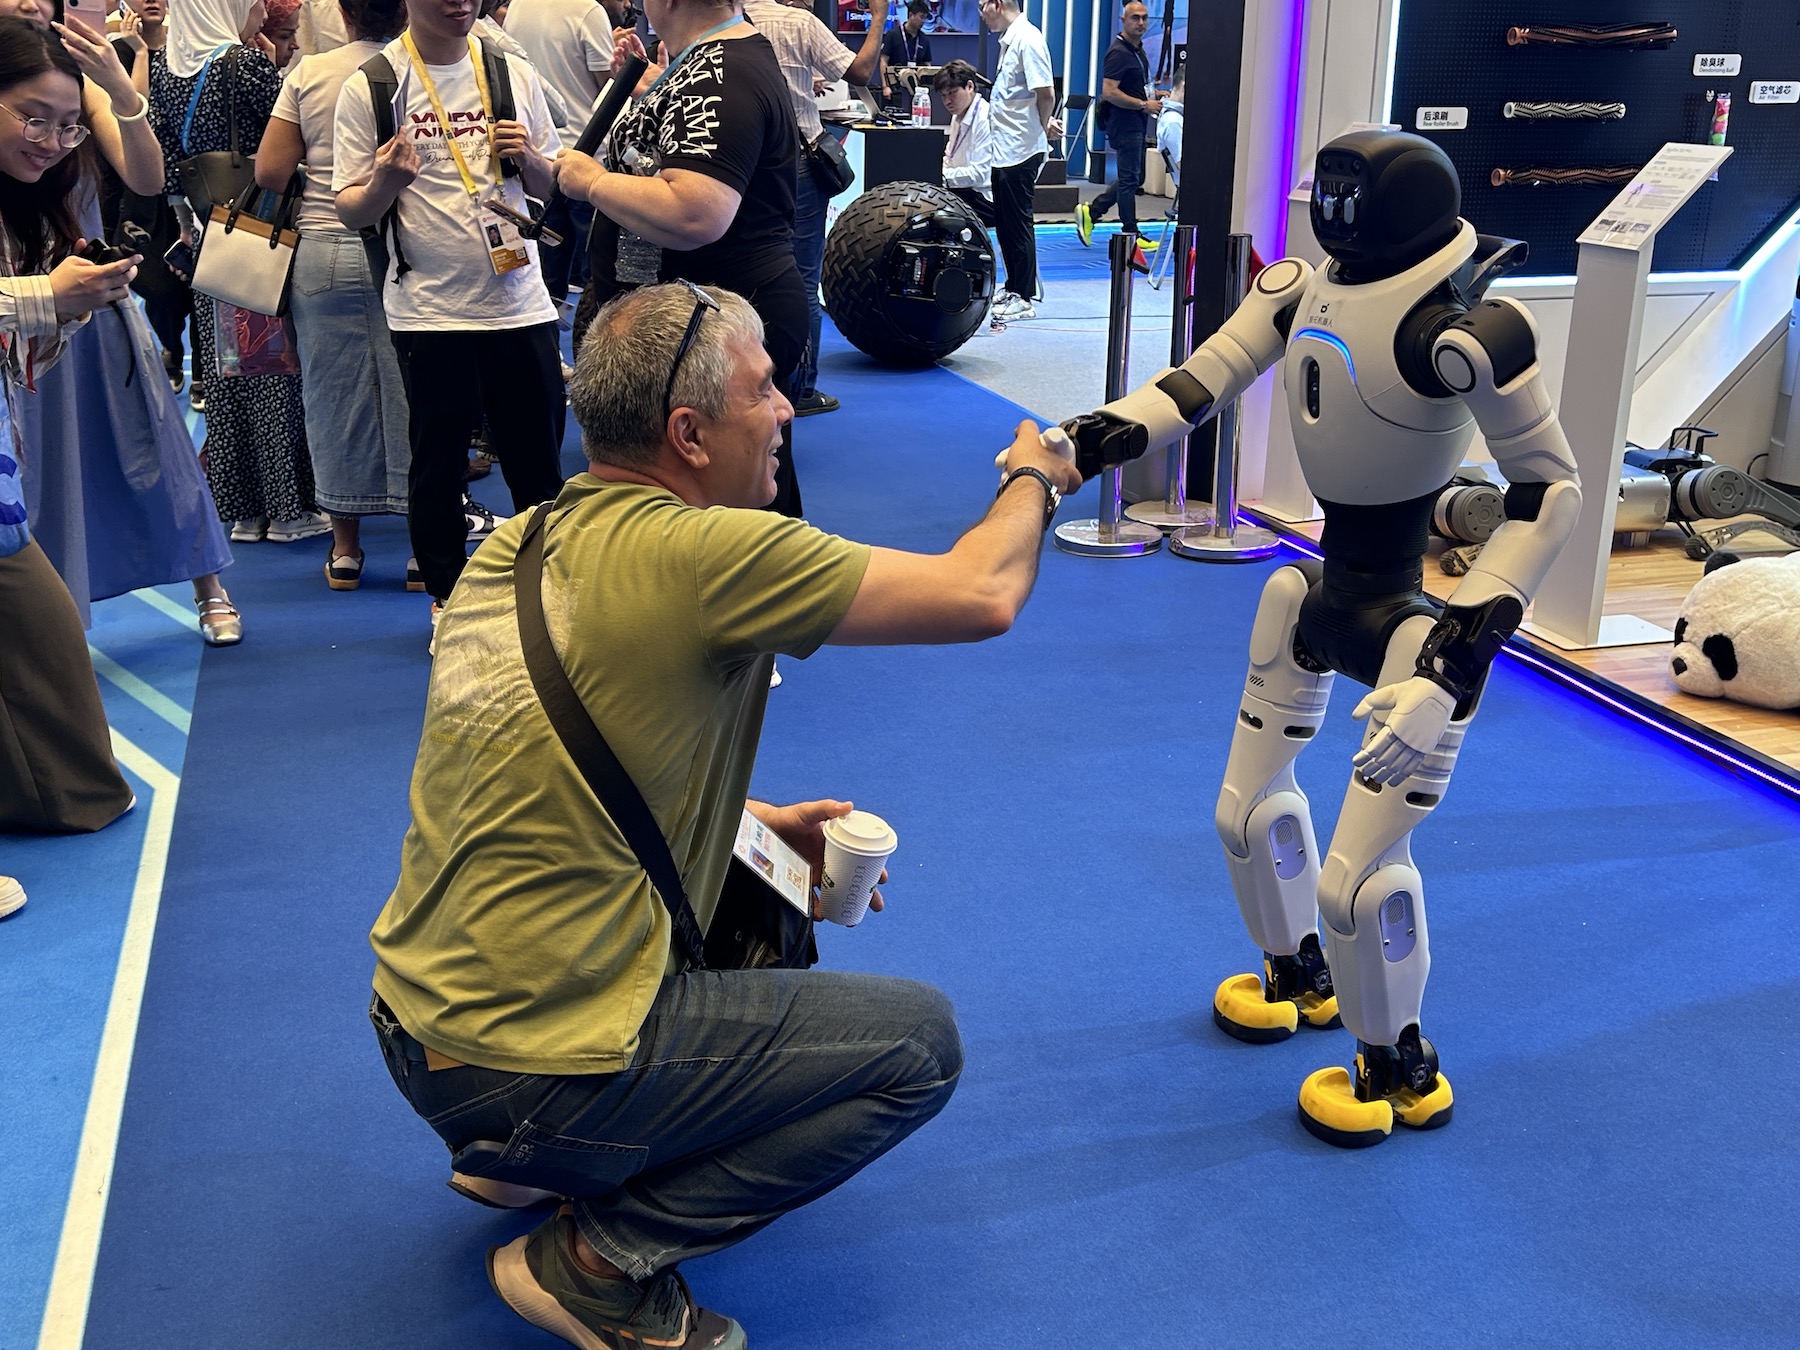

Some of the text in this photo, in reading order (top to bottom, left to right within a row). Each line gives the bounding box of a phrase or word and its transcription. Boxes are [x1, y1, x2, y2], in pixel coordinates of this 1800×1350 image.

[1700, 57, 1726, 67] 除臭球
[1760, 85, 1792, 95] 空气滤芯
[1423, 111, 1448, 121] 后滚刷
